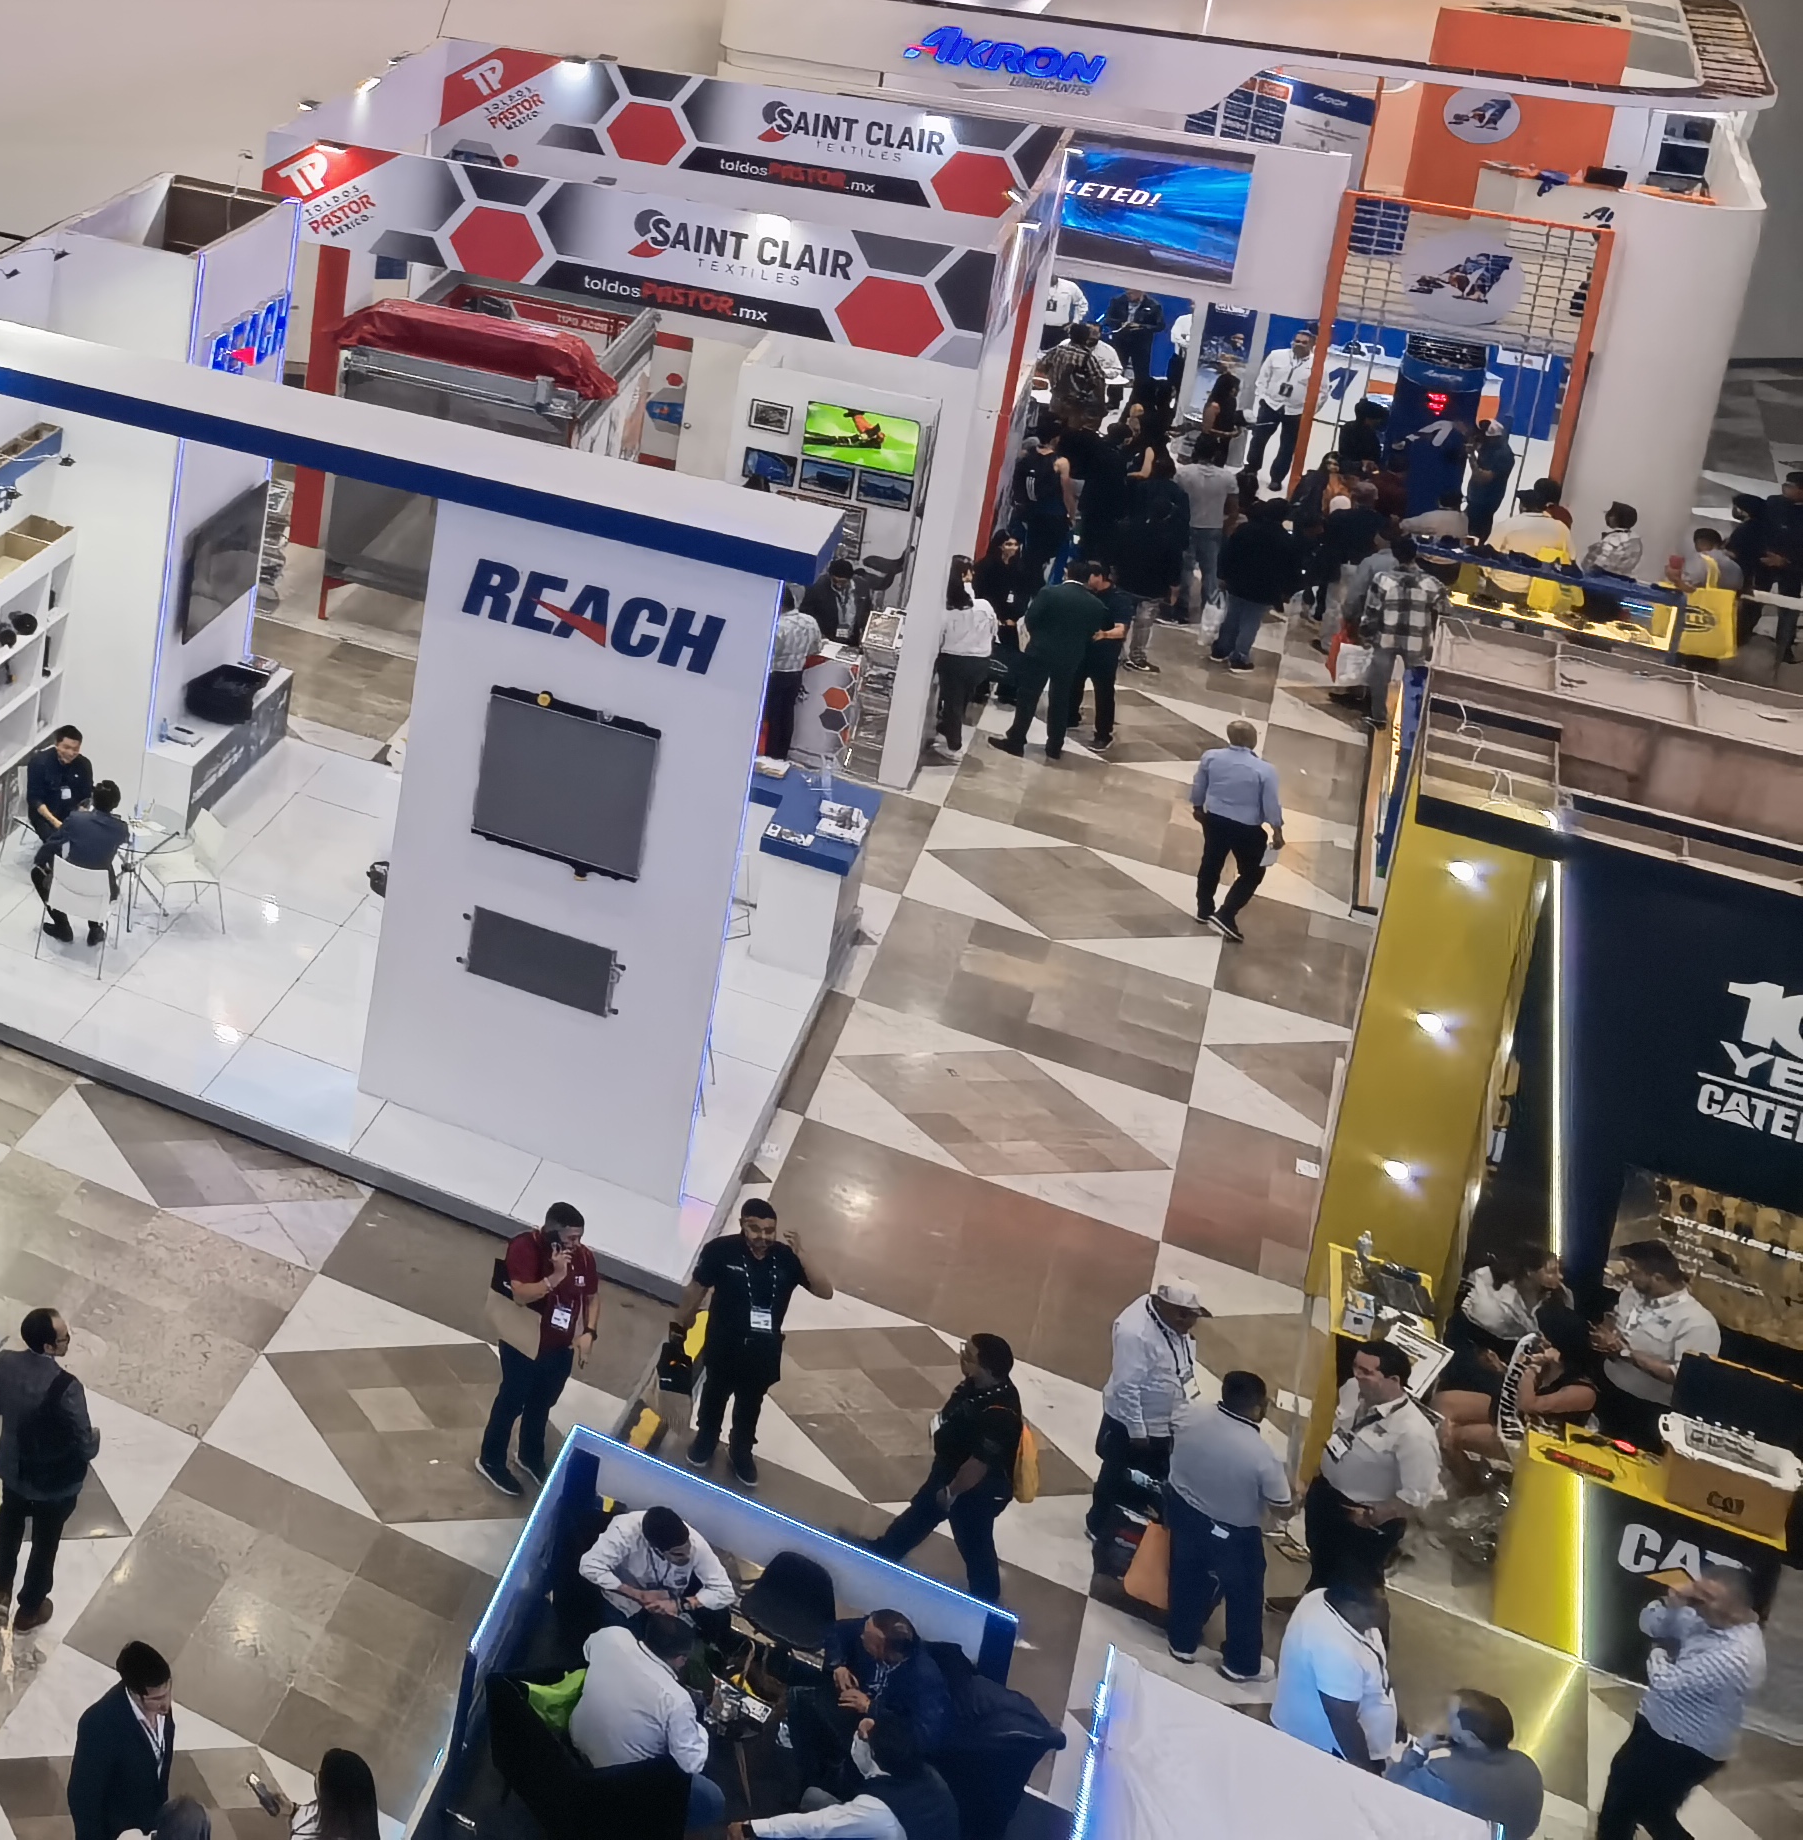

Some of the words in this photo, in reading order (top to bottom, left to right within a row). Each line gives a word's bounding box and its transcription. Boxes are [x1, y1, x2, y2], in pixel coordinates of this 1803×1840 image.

[903, 25, 1107, 84] AKRON
[774, 107, 859, 144] SAINT
[864, 121, 946, 156] CLAIR
[308, 193, 377, 235] PASTOR
[650, 217, 750, 259] SAINT
[755, 236, 855, 282] CLAIR
[696, 256, 801, 287] TEXTILES
[461, 557, 727, 675] REACH
